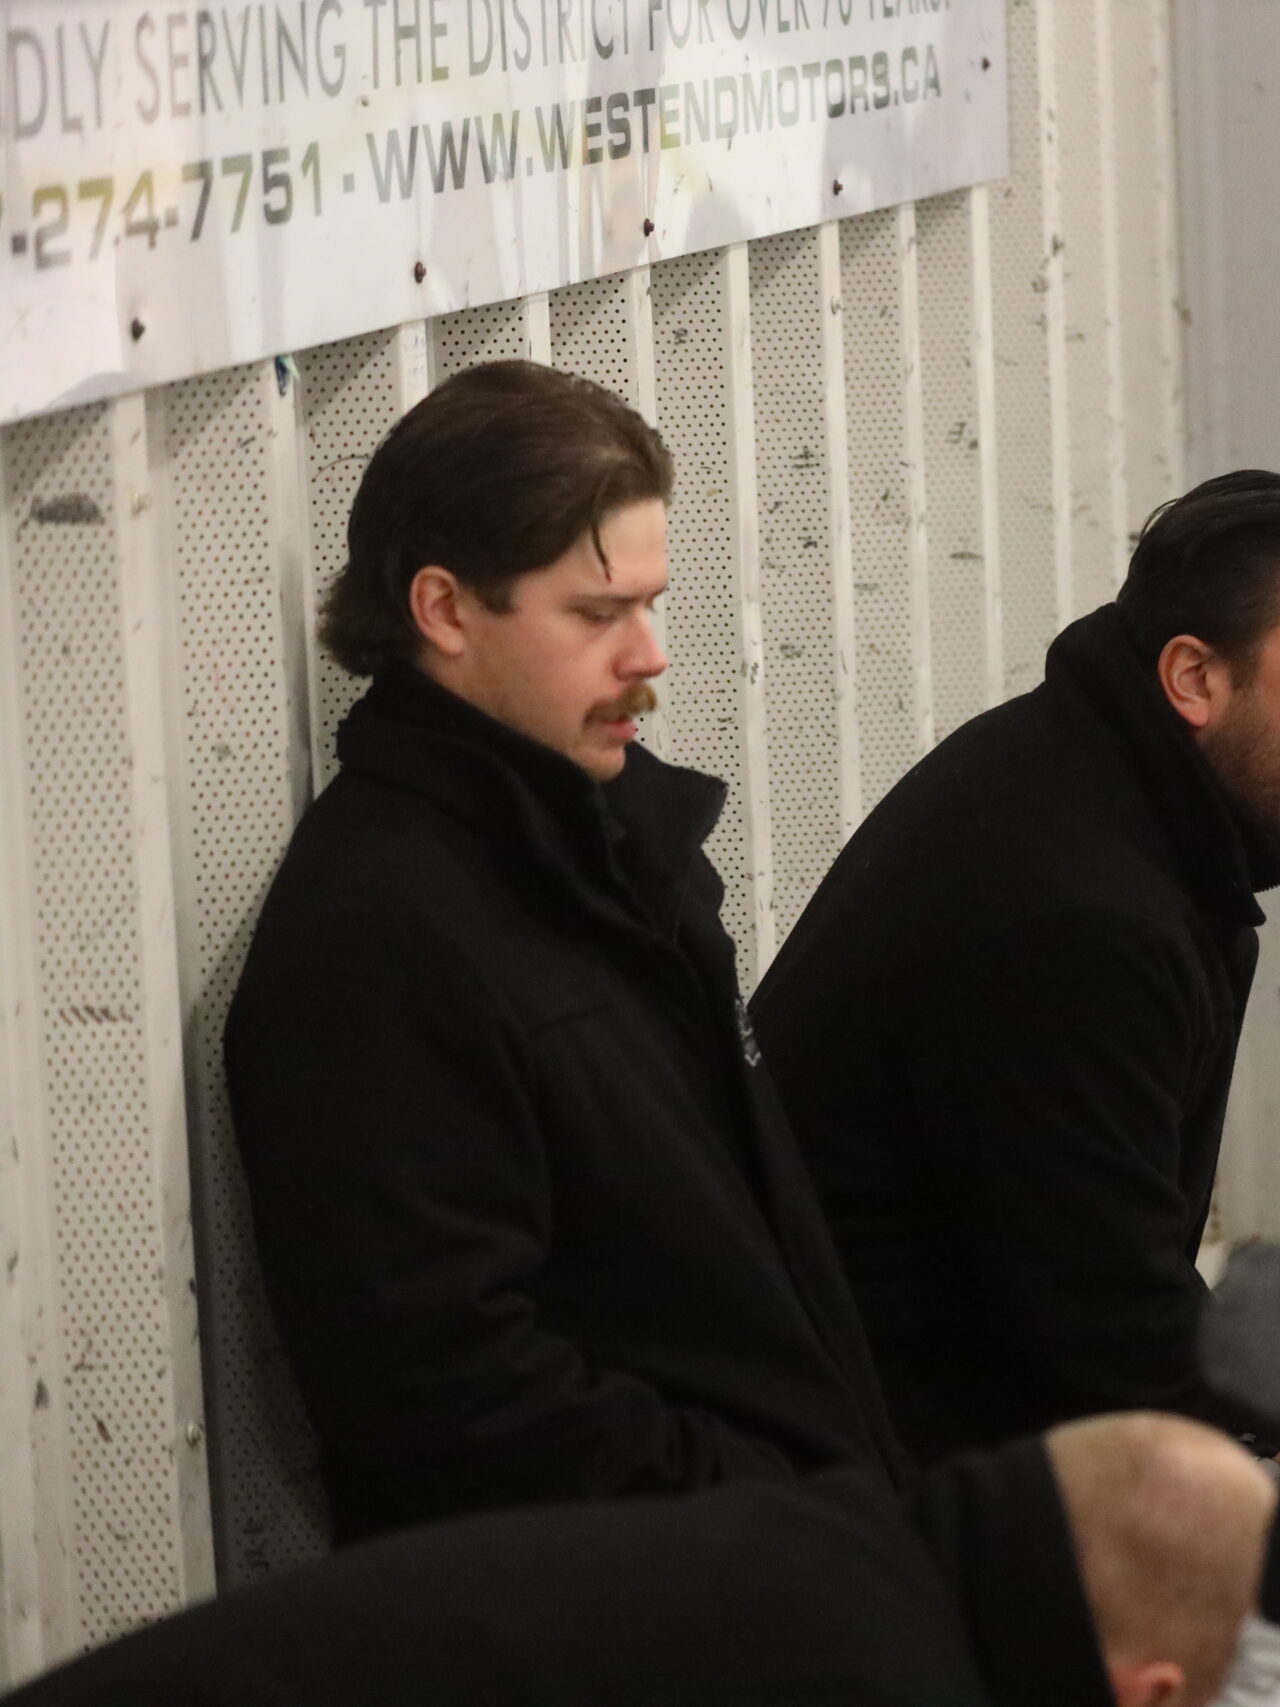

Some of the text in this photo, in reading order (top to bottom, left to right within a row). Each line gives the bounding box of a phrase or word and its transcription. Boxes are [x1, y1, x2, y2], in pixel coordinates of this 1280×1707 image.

[135, 2, 346, 124] SERVING
[363, 0, 449, 89] THE
[467, 0, 630, 76] DISTRICT
[366, 44, 941, 203] WWW.WESTENDMOTORS.CA
